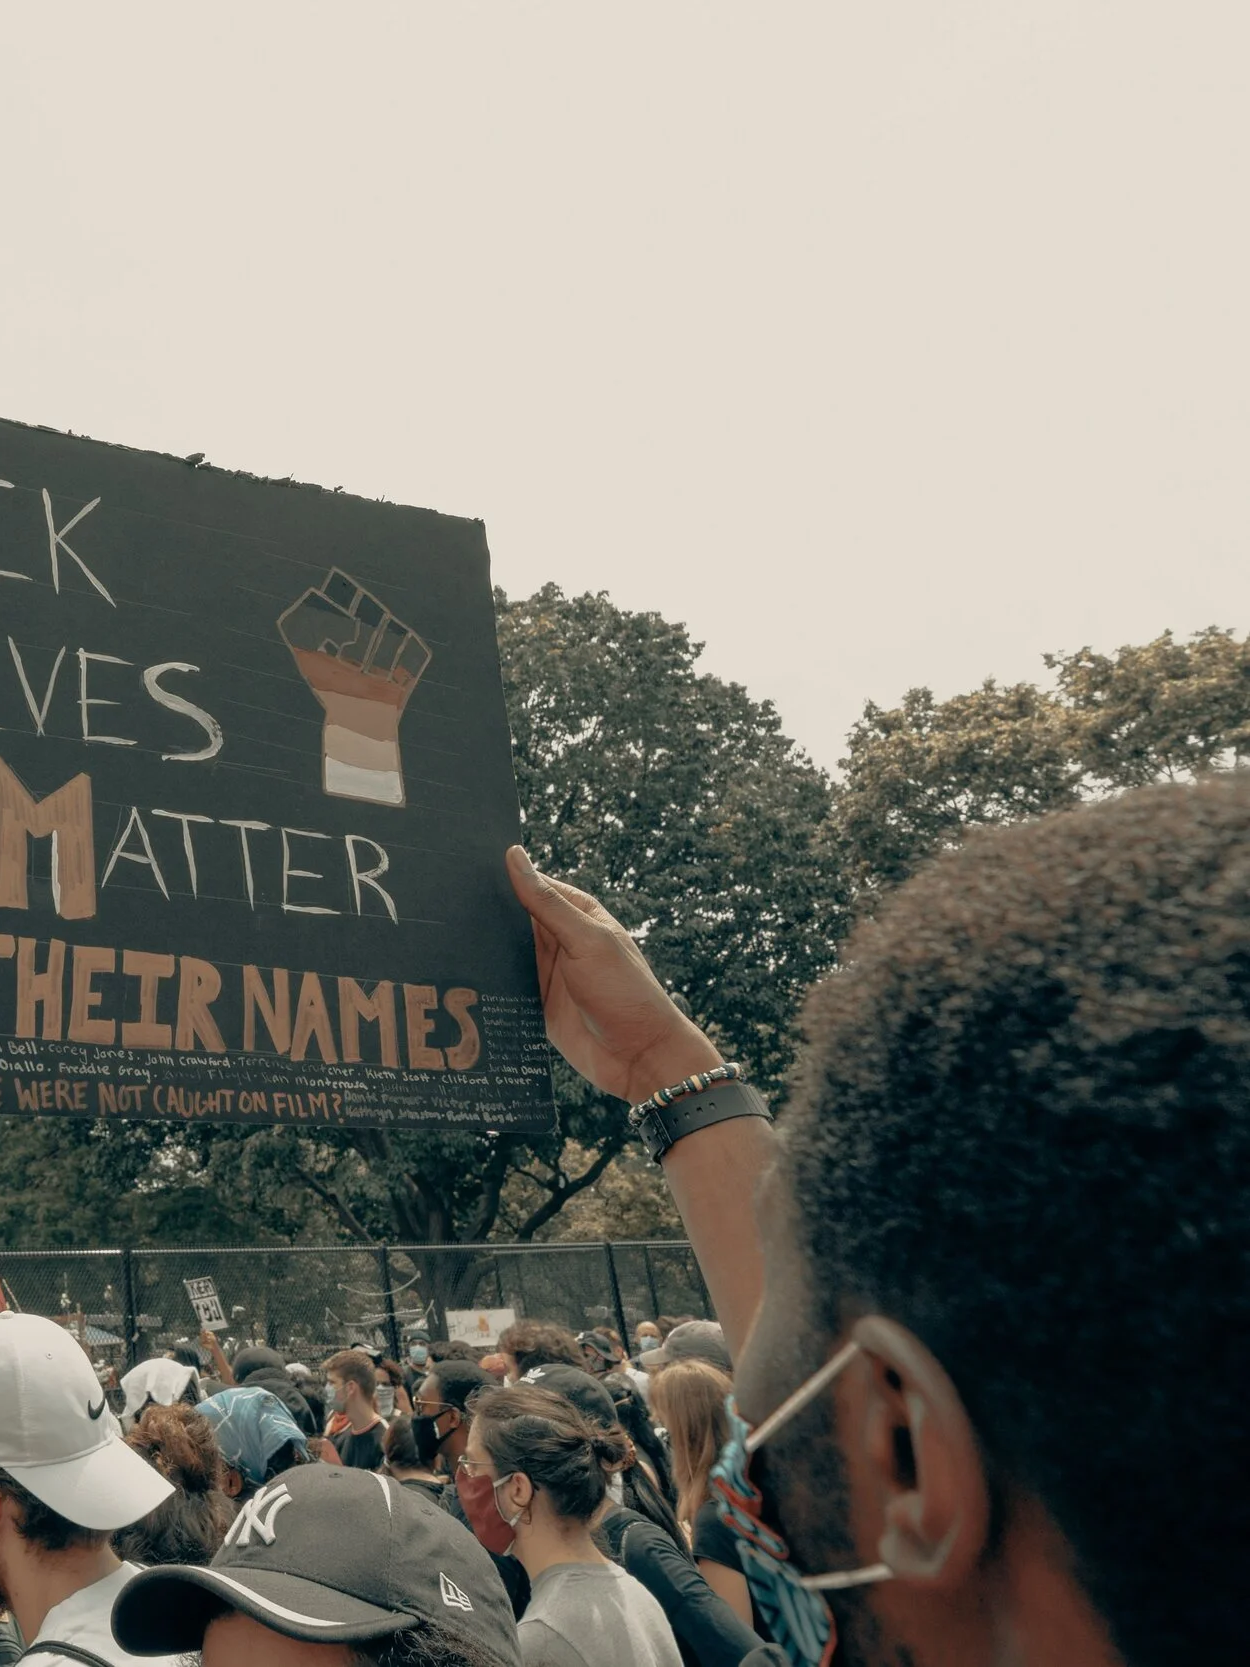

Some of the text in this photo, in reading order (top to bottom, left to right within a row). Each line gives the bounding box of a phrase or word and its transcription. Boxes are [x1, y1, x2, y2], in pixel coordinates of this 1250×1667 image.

[243, 963, 481, 1071] NAMES
[7, 1040, 38, 1055] Bell
[93, 1047, 134, 1060] Jones
[144, 1053, 175, 1066] John
[402, 1071, 430, 1082] Scott
[58, 1062, 110, 1076] Freddie
[118, 1065, 152, 1084] Gray
[14, 1077, 89, 1111] WERE
[97, 1081, 148, 1115] NOT
[153, 1085, 235, 1118] CAUGHT
[238, 1090, 268, 1114] ON
